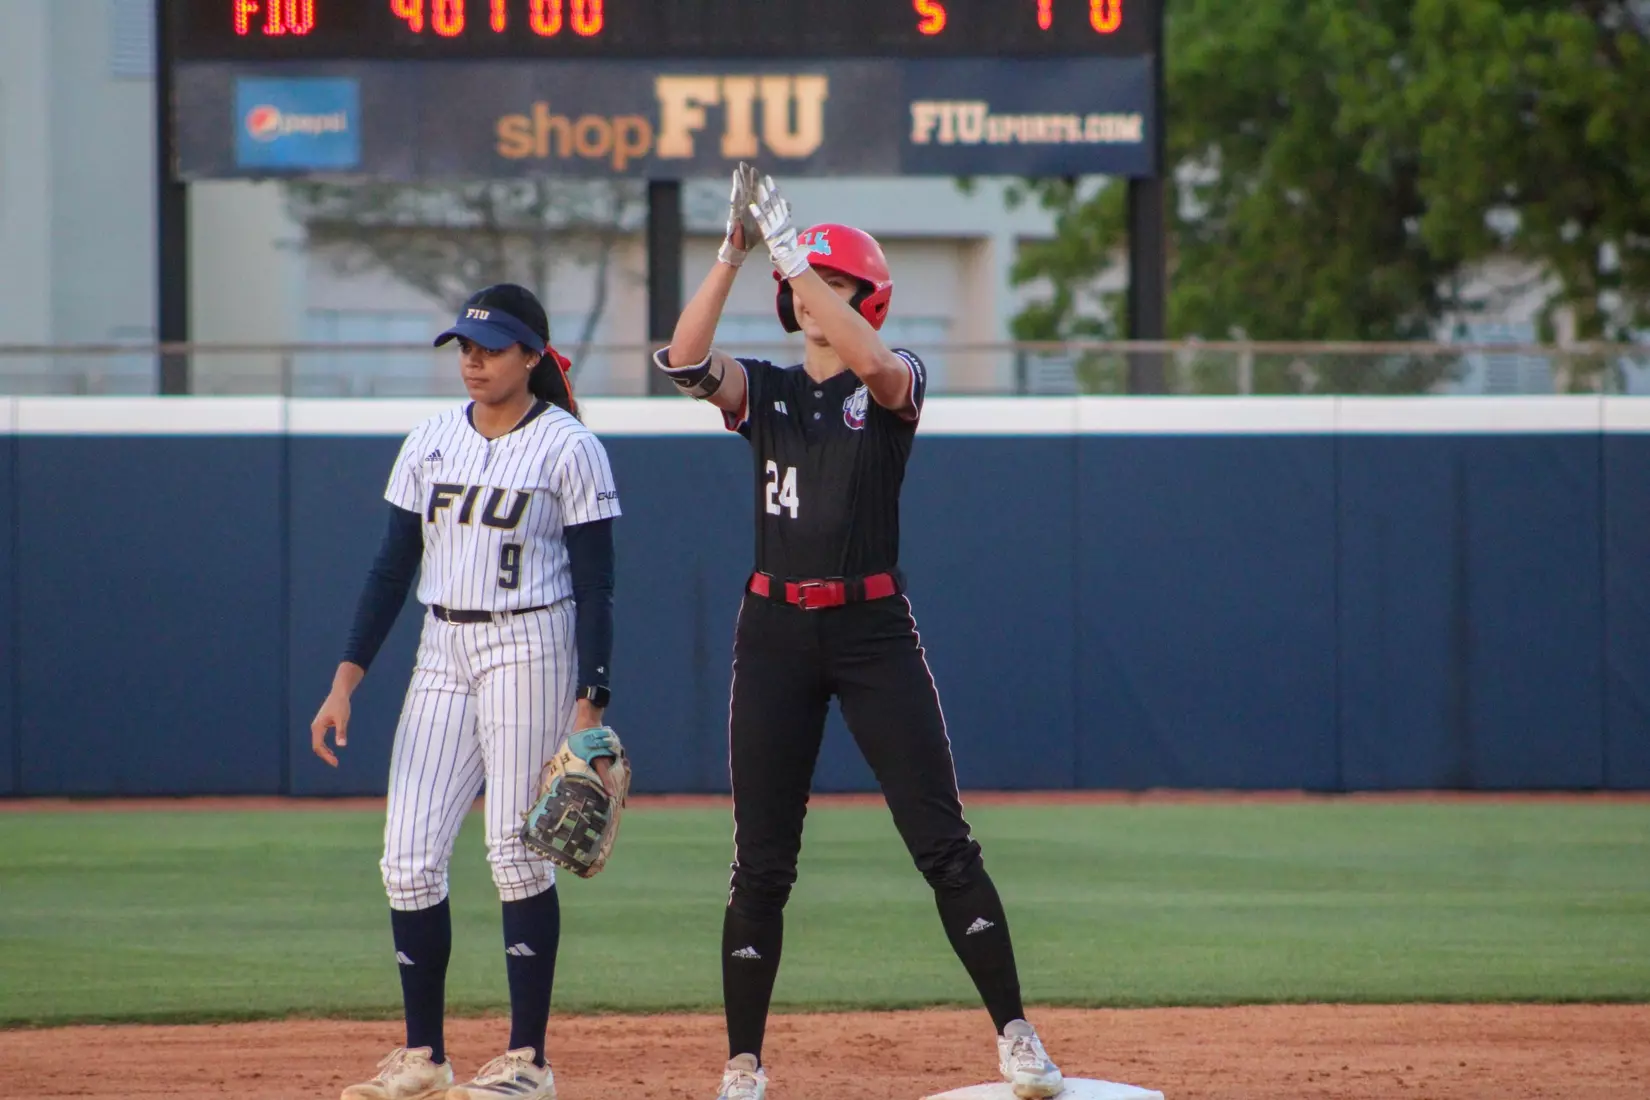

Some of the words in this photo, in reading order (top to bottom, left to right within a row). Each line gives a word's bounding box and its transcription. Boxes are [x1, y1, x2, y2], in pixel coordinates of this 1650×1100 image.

[465, 308, 490, 320] FIU
[427, 482, 531, 529] FIU
[765, 459, 800, 519] 24
[498, 543, 524, 590] 9
